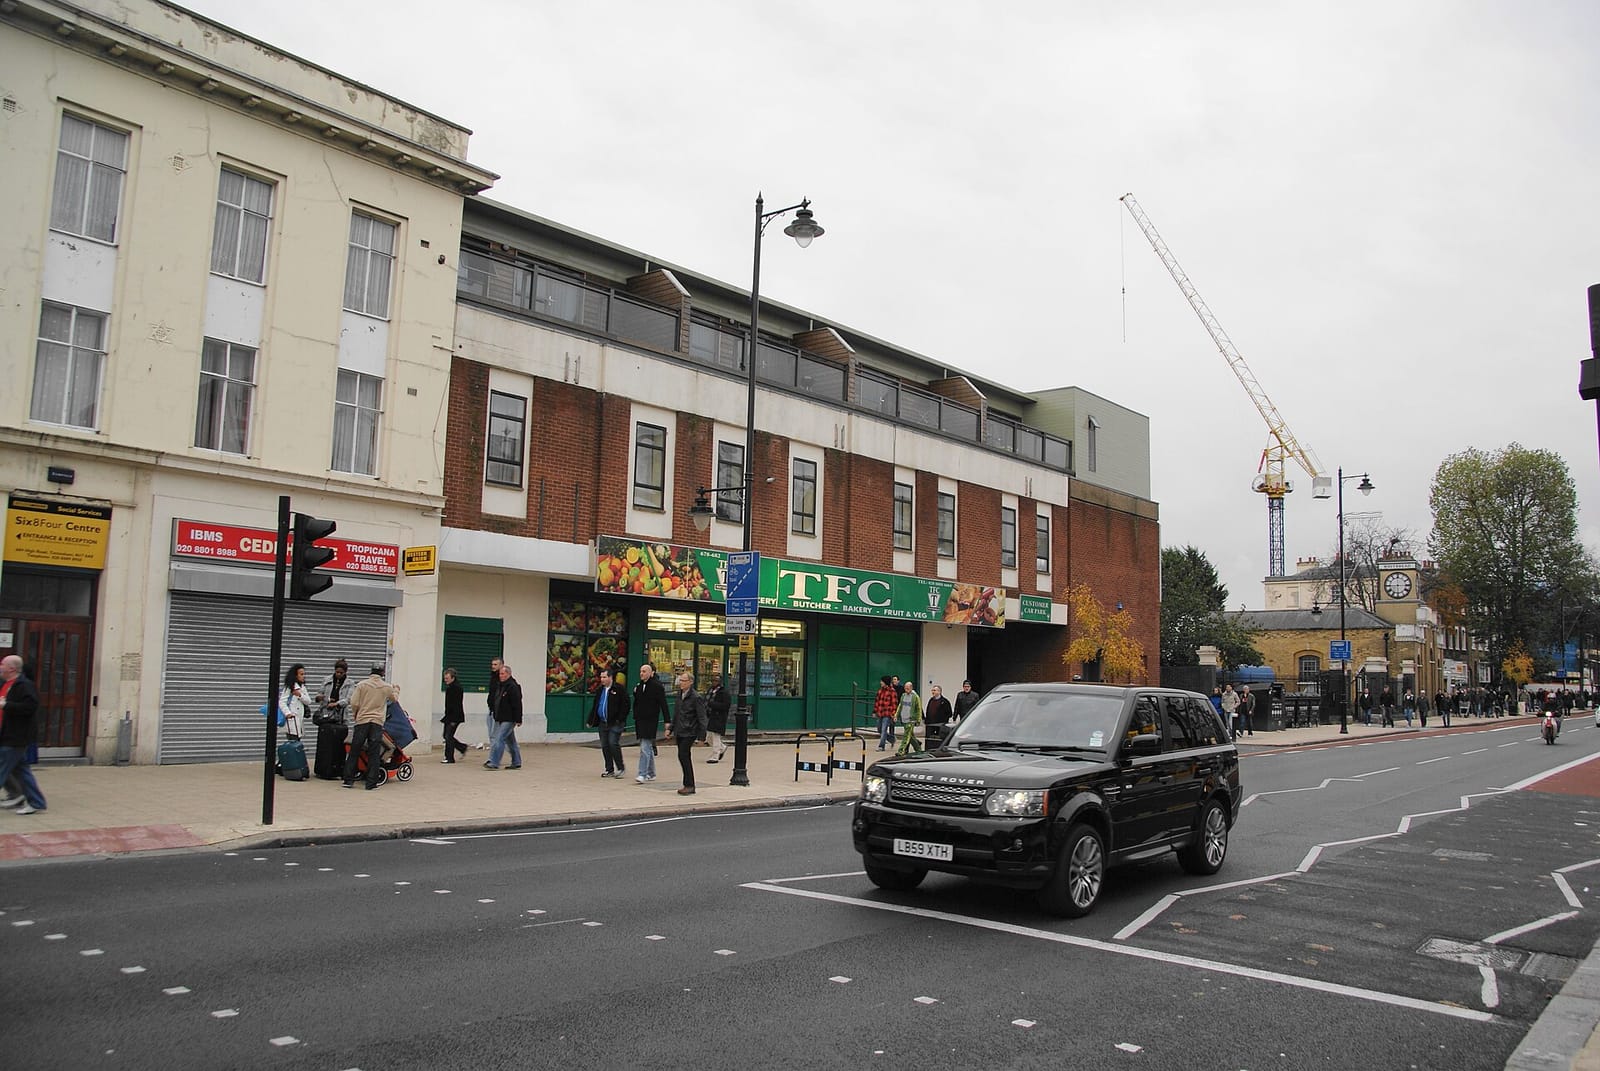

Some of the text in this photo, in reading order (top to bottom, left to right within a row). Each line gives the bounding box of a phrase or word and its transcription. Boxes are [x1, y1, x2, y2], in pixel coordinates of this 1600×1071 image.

[57, 506, 102, 517] Social Services
[65, 521, 101, 534] Centre
[22, 532, 57, 541] ENTRANCE
[64, 536, 98, 545] RECEPTION
[190, 529, 223, 542] IBMS
[177, 544, 237, 557] 020 8801 8988
[346, 544, 395, 557] TROPICANA
[354, 554, 388, 566] TRAVEL
[718, 559, 728, 569] TF
[346, 562, 360, 570] 020
[361, 563, 378, 572] 8885
[779, 569, 891, 607] TFC
[793, 600, 831, 610] BUTCHER
[843, 605, 872, 614] BAKERY
[884, 609, 905, 617] FRUIT
[1022, 599, 1050, 608] CUSTOMER
[894, 772, 985, 785] RANGE ROVER
[898, 840, 949, 858] LB59 XTH
